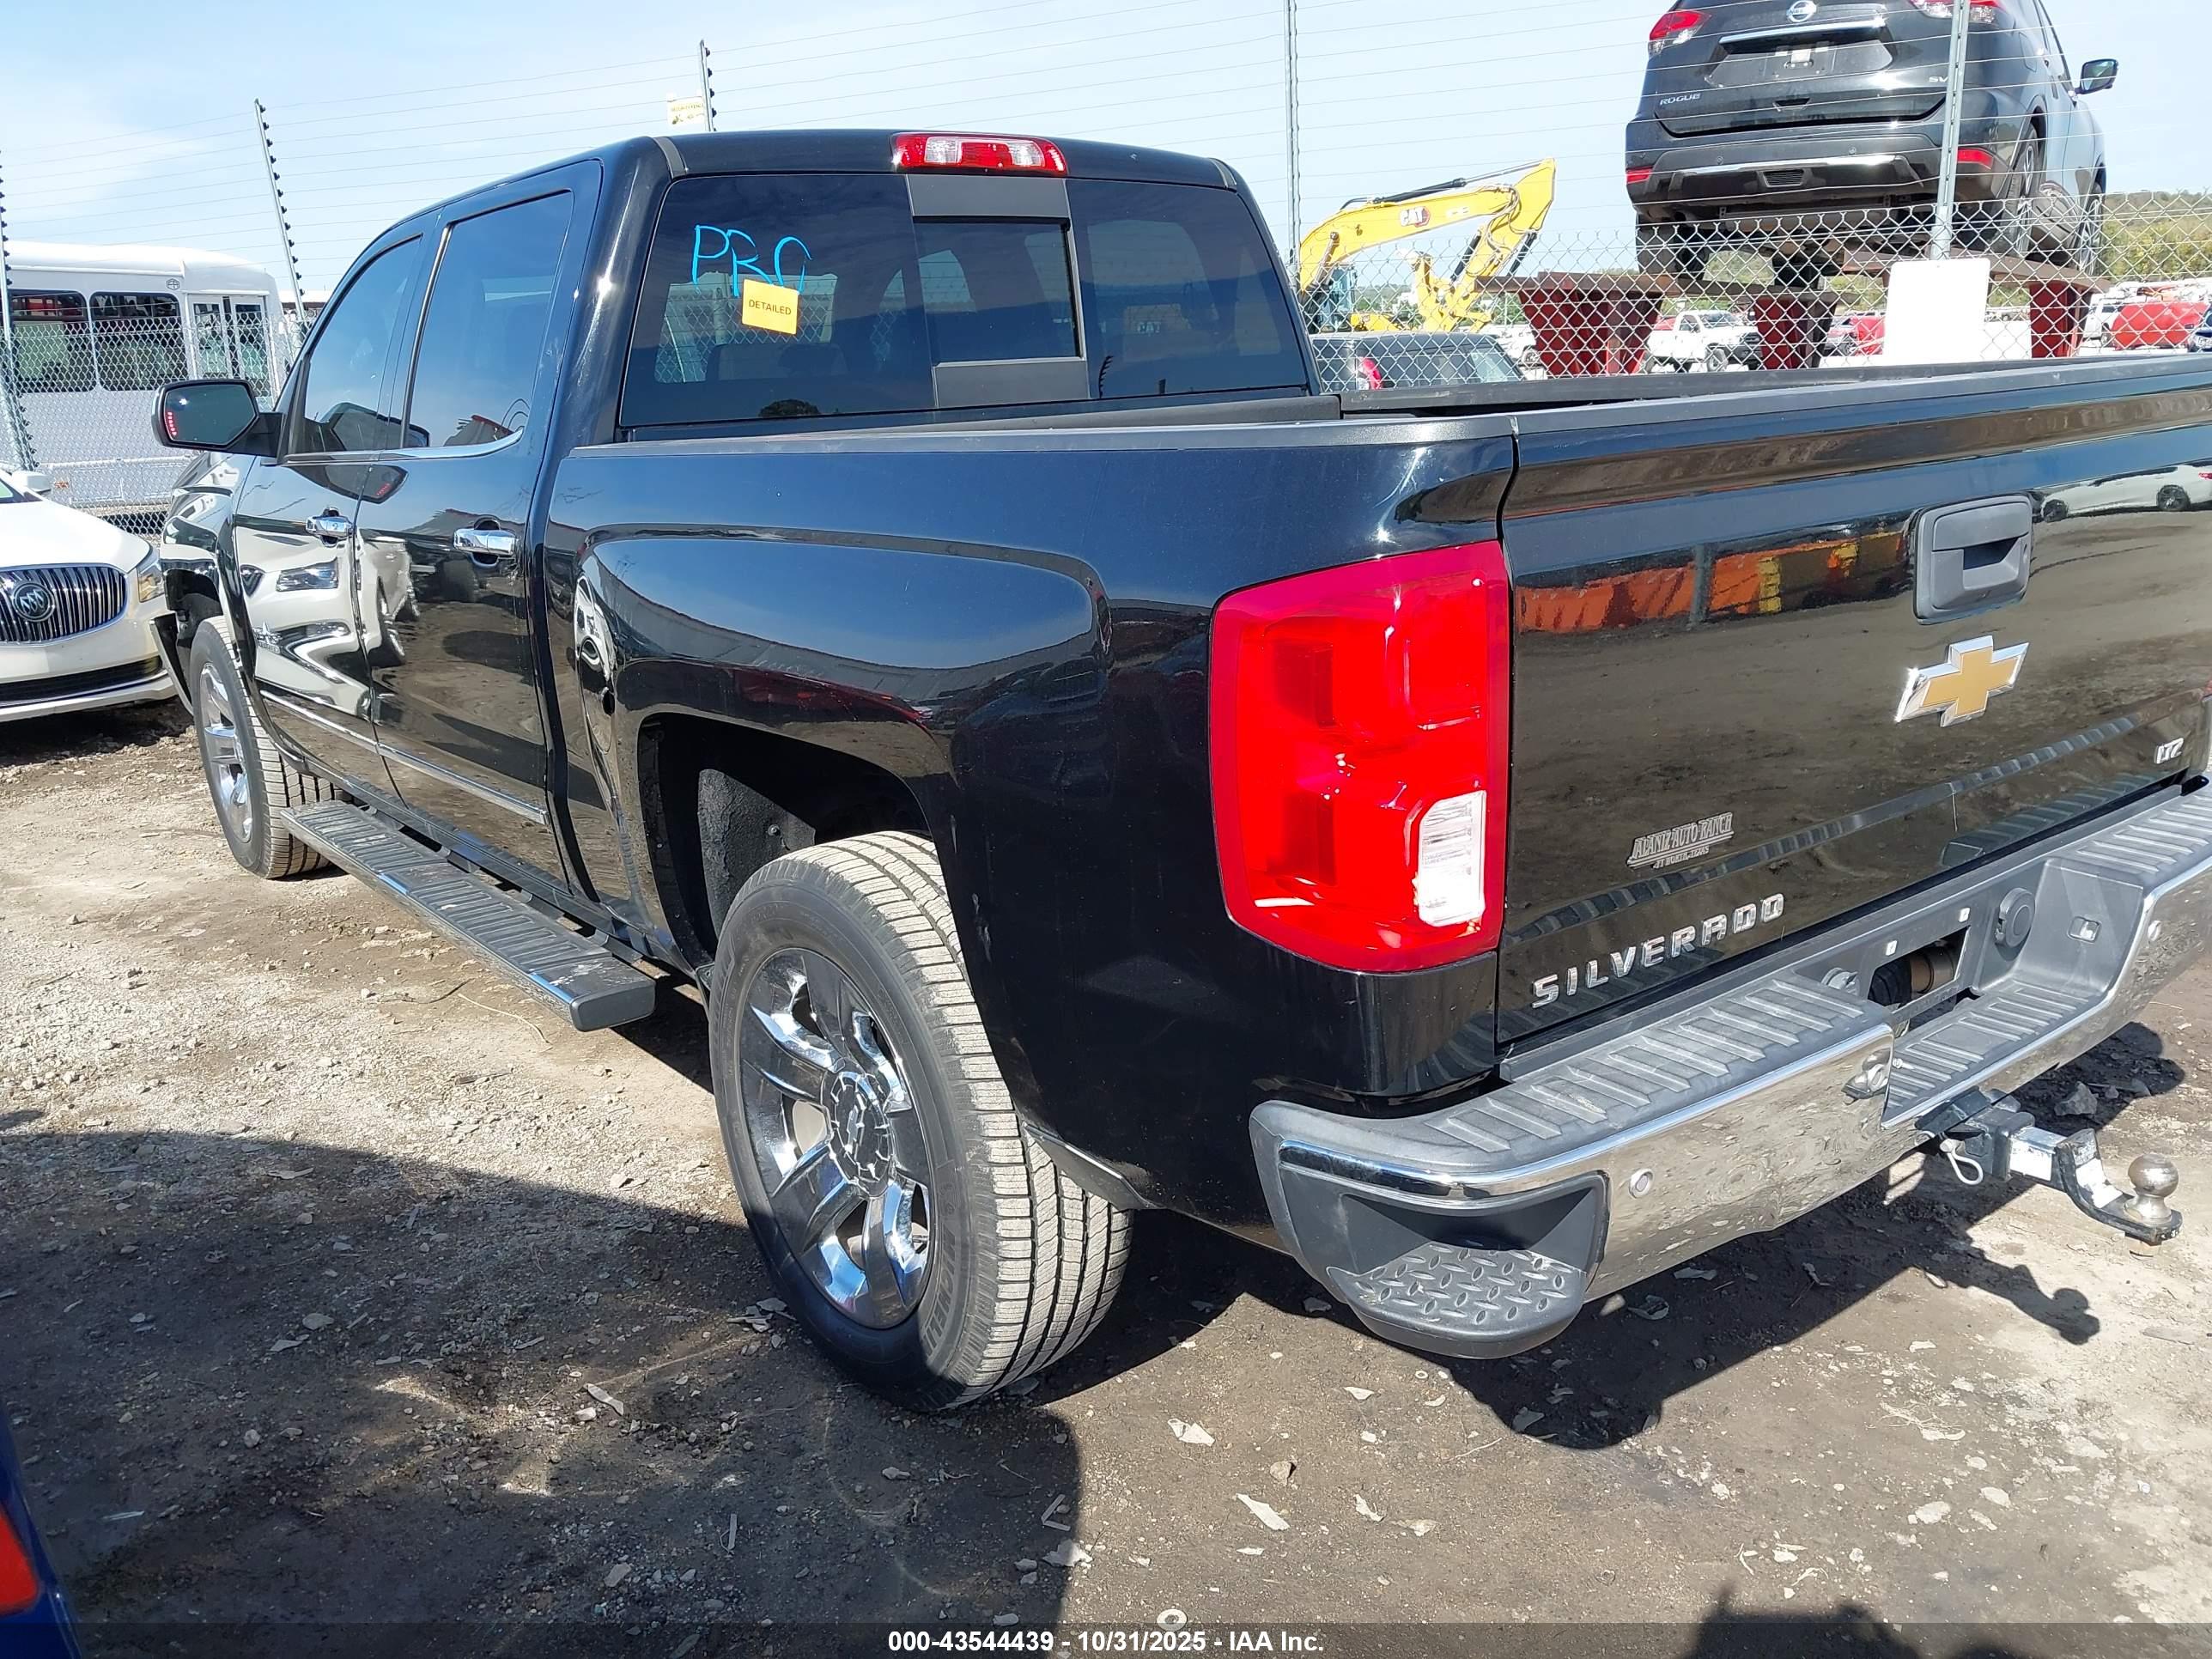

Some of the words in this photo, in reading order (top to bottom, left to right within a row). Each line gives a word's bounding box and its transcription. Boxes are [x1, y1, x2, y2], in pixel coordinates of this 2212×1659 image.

[1659, 93, 1701, 106] ROGUE
[1400, 205, 1424, 227] CAT
[748, 299, 792, 315] DETAILED
[2154, 737, 2185, 764] LTZ
[1671, 822, 1698, 848] AUTO
[1698, 811, 1733, 840] RANCH
[1532, 893, 1785, 1009] SILVERADO
